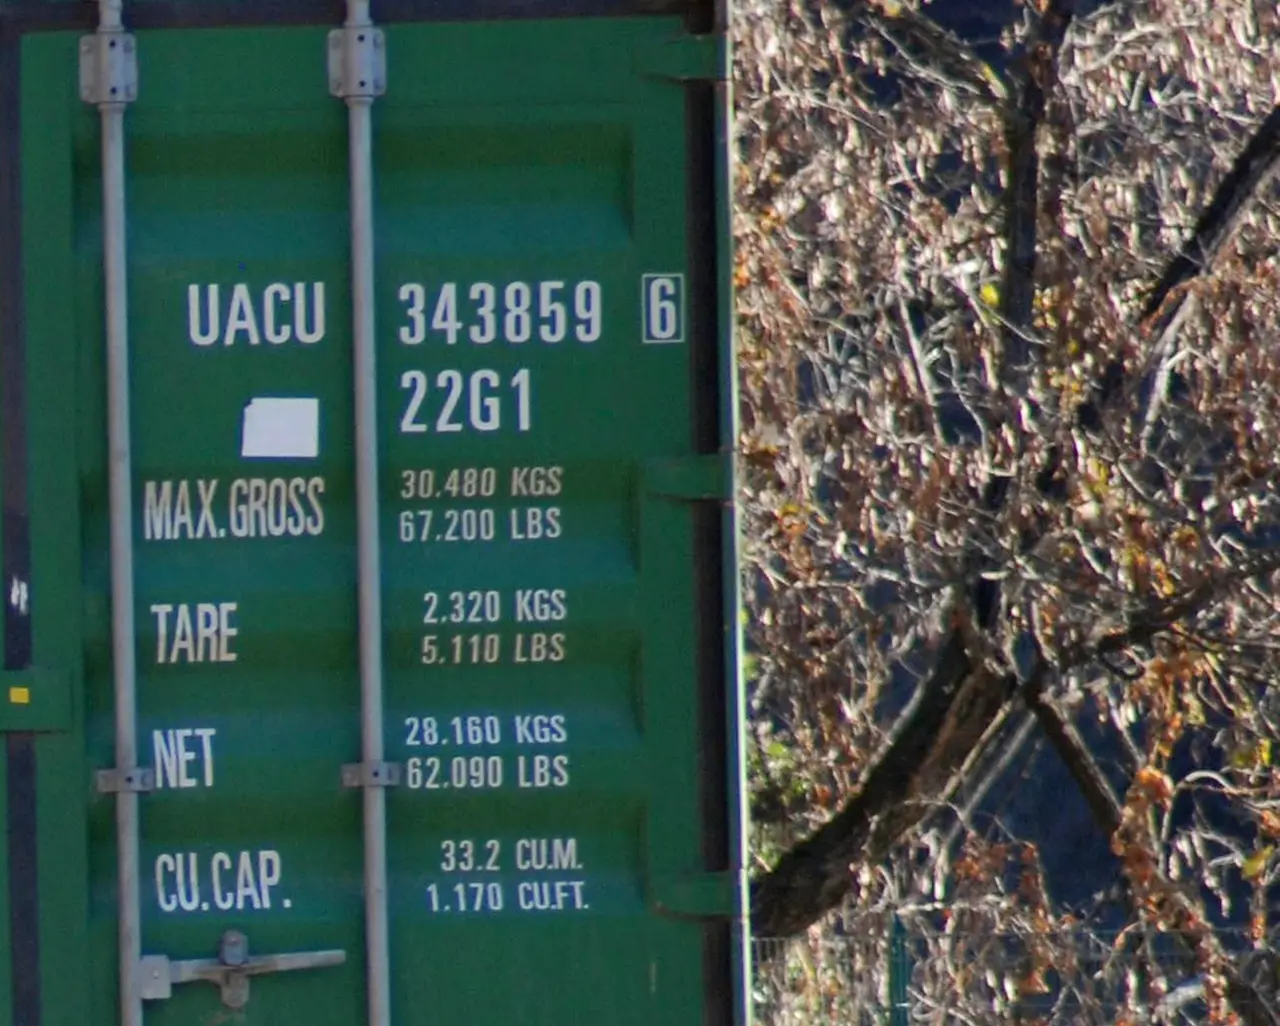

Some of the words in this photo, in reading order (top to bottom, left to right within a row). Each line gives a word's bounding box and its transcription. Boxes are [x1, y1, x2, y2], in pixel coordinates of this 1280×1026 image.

[188, 281, 326, 346] UACU
[398, 280, 602, 345] 343859
[650, 277, 676, 340] 6
[400, 368, 531, 433] 22G1
[400, 467, 496, 500] 30.480
[511, 466, 564, 497] KGS
[144, 476, 326, 541] MAX.GROSS
[399, 508, 495, 543] 67.200
[510, 507, 562, 540] LBS
[423, 590, 501, 624] 2.320
[515, 589, 567, 622] KGS
[150, 602, 238, 664] TARE
[421, 633, 500, 665] 5.110
[514, 632, 566, 663] LBS
[405, 715, 501, 747] 28.160
[515, 714, 568, 745] KGS
[153, 728, 216, 789] NET
[407, 755, 503, 790] 62.090
[518, 754, 570, 788] LBS
[440, 839, 500, 873] 33.2
[516, 838, 584, 871] CU.M.
[155, 849, 293, 912] CU.CAP.
[426, 882, 503, 913] 1.170
[518, 880, 590, 911] CU.FT.
